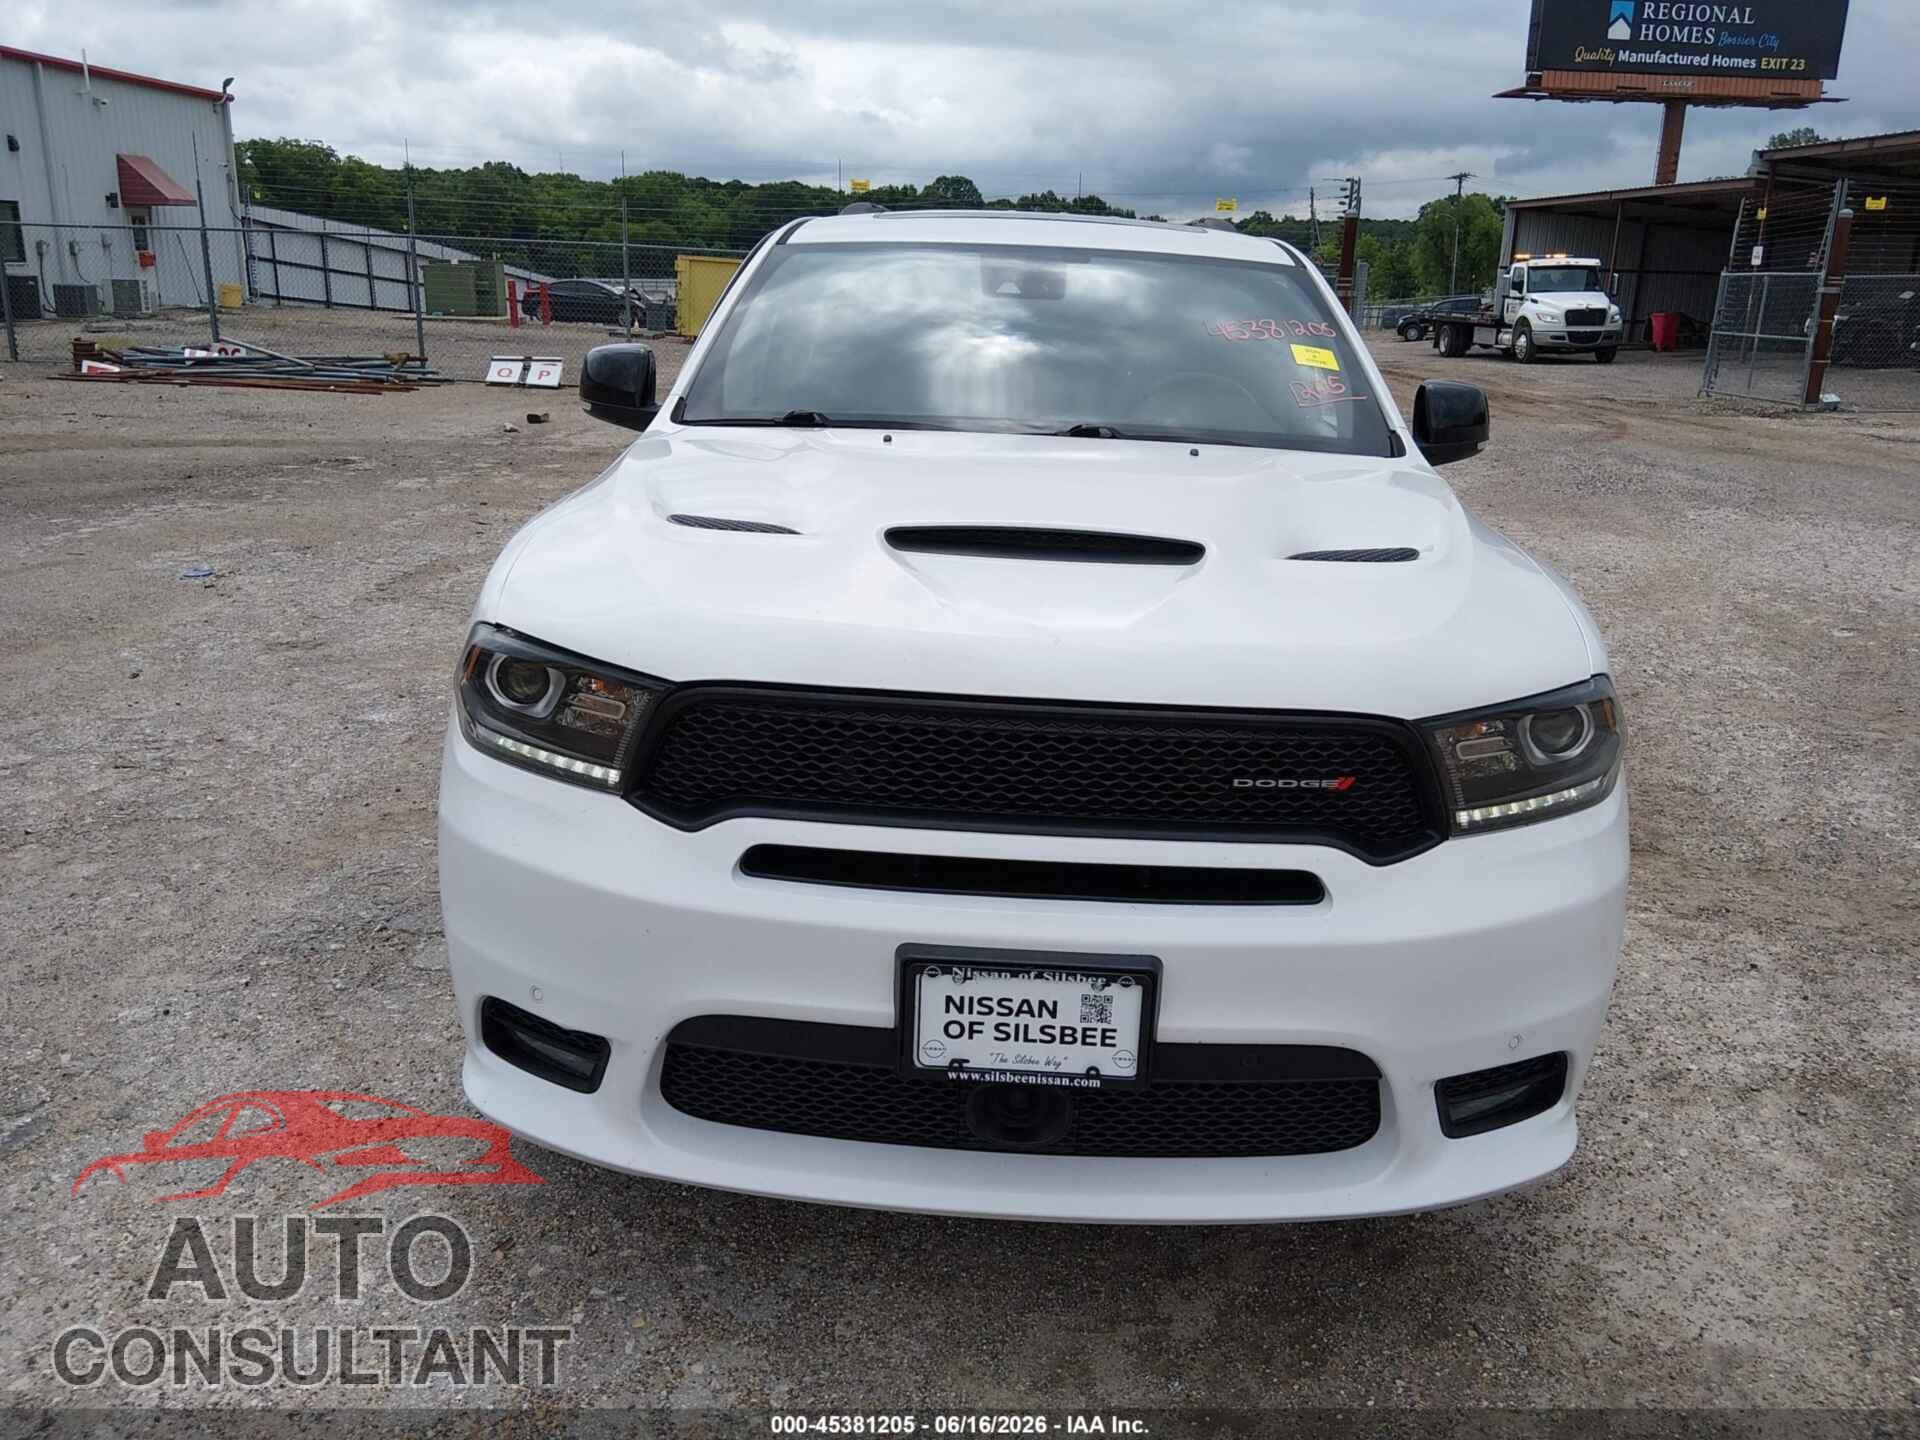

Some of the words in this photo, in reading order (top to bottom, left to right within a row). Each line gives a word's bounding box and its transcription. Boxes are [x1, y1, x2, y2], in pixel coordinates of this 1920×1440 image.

[1642, 2, 1755, 24] REGIONAL
[1640, 24, 1715, 44] HOMES
[1758, 32, 1779, 52] City
[1575, 46, 1615, 67] Quality
[1618, 50, 1709, 67] Manufactured
[1712, 54, 1756, 69] Homes
[1760, 57, 1788, 69] EXIT
[1790, 59, 1805, 70] 23
[1203, 319, 1336, 340] 45381205
[1233, 779, 1338, 788] DODGE
[944, 995, 1057, 1019] NISSAN
[943, 1020, 984, 1040] OF
[993, 1022, 1117, 1047] SILSBEE
[947, 1070, 1100, 1087] www.silsbeenissan.com
